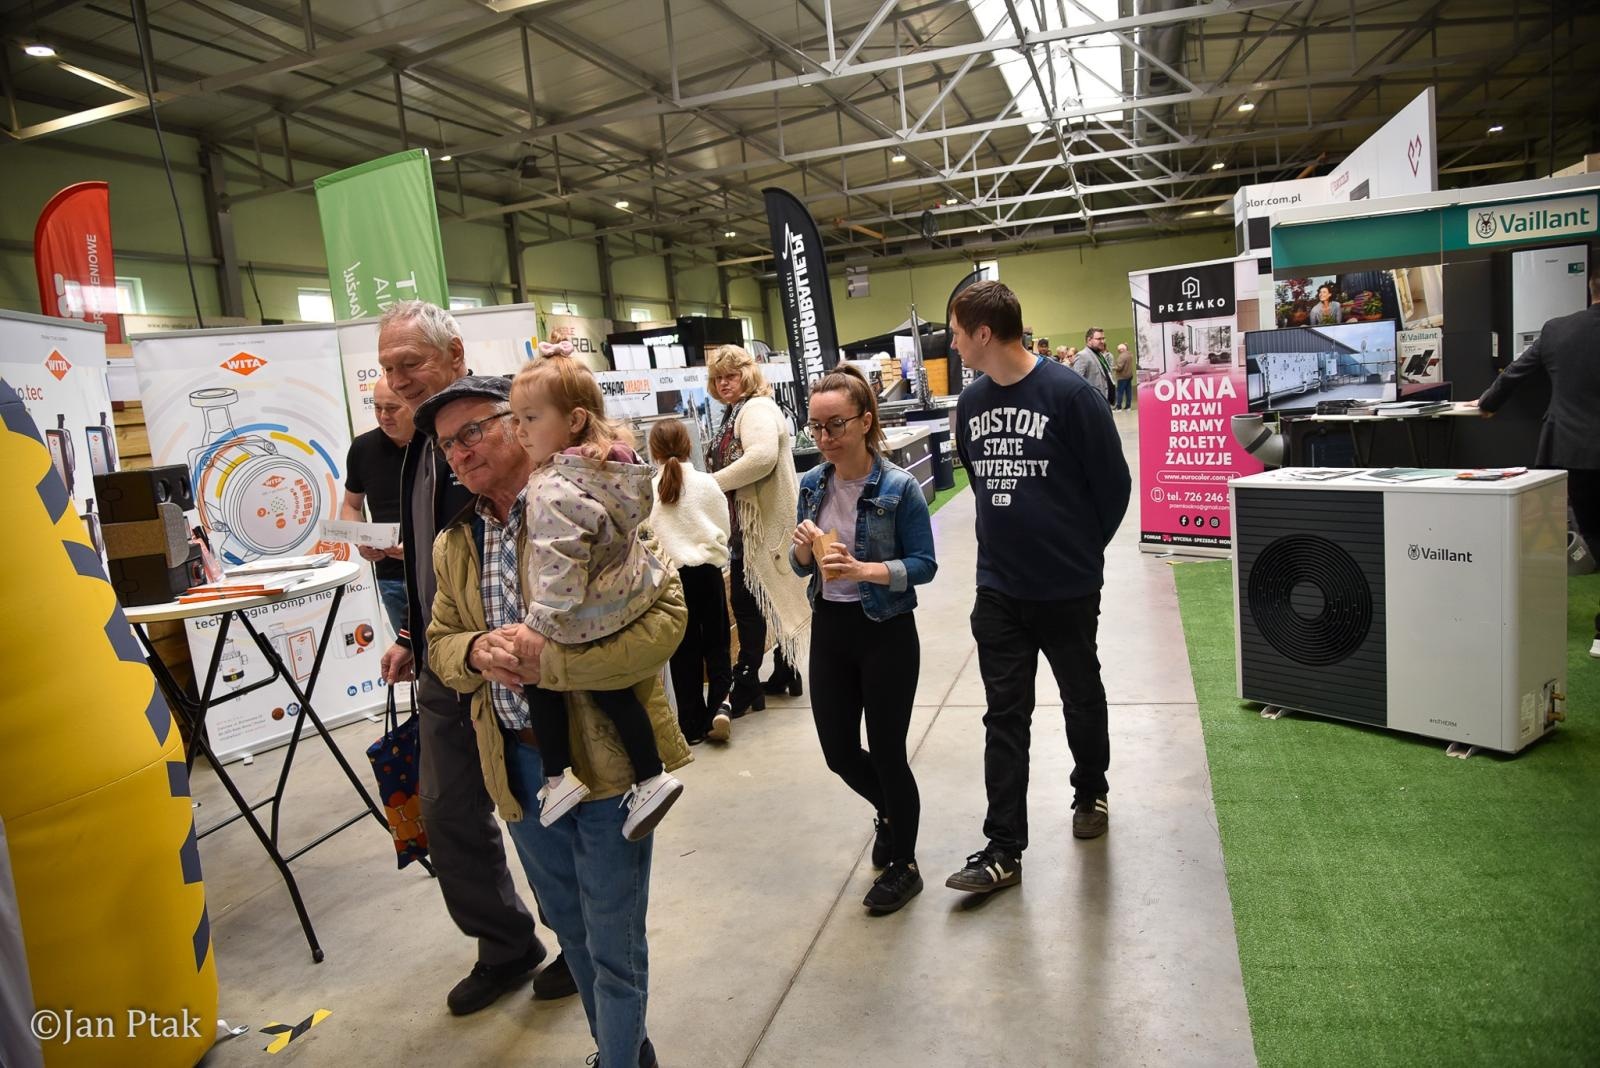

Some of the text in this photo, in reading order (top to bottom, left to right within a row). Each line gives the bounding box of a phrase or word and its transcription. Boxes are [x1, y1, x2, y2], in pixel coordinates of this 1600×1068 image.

[1246, 193, 1302, 208] olor.com.pl
[1499, 207, 1590, 234] Vaillant
[1158, 298, 1226, 314] PRZEMKO
[1407, 332, 1438, 341] Vaillant
[47, 359, 68, 372] WITA
[226, 358, 262, 370] WITA
[17, 385, 44, 401] o.tec
[1154, 376, 1237, 402] OKNA
[1170, 402, 1222, 417] DRZWI
[968, 407, 1049, 441] BOSTON
[1170, 418, 1224, 433] BRAMY
[983, 438, 1024, 456] STATE
[1168, 435, 1227, 449] ROLETY
[1165, 449, 1232, 465] ŻALUZJE
[986, 478, 1018, 489] 617 857
[1164, 473, 1234, 481] www.eurocolor.com.pl
[994, 495, 1008, 505] B.C.
[1167, 491, 1182, 501] tel.
[1184, 491, 1202, 502] 726
[1204, 492, 1224, 502] 246
[1421, 546, 1473, 563] Vaillant
[272, 595, 306, 614] pomp
